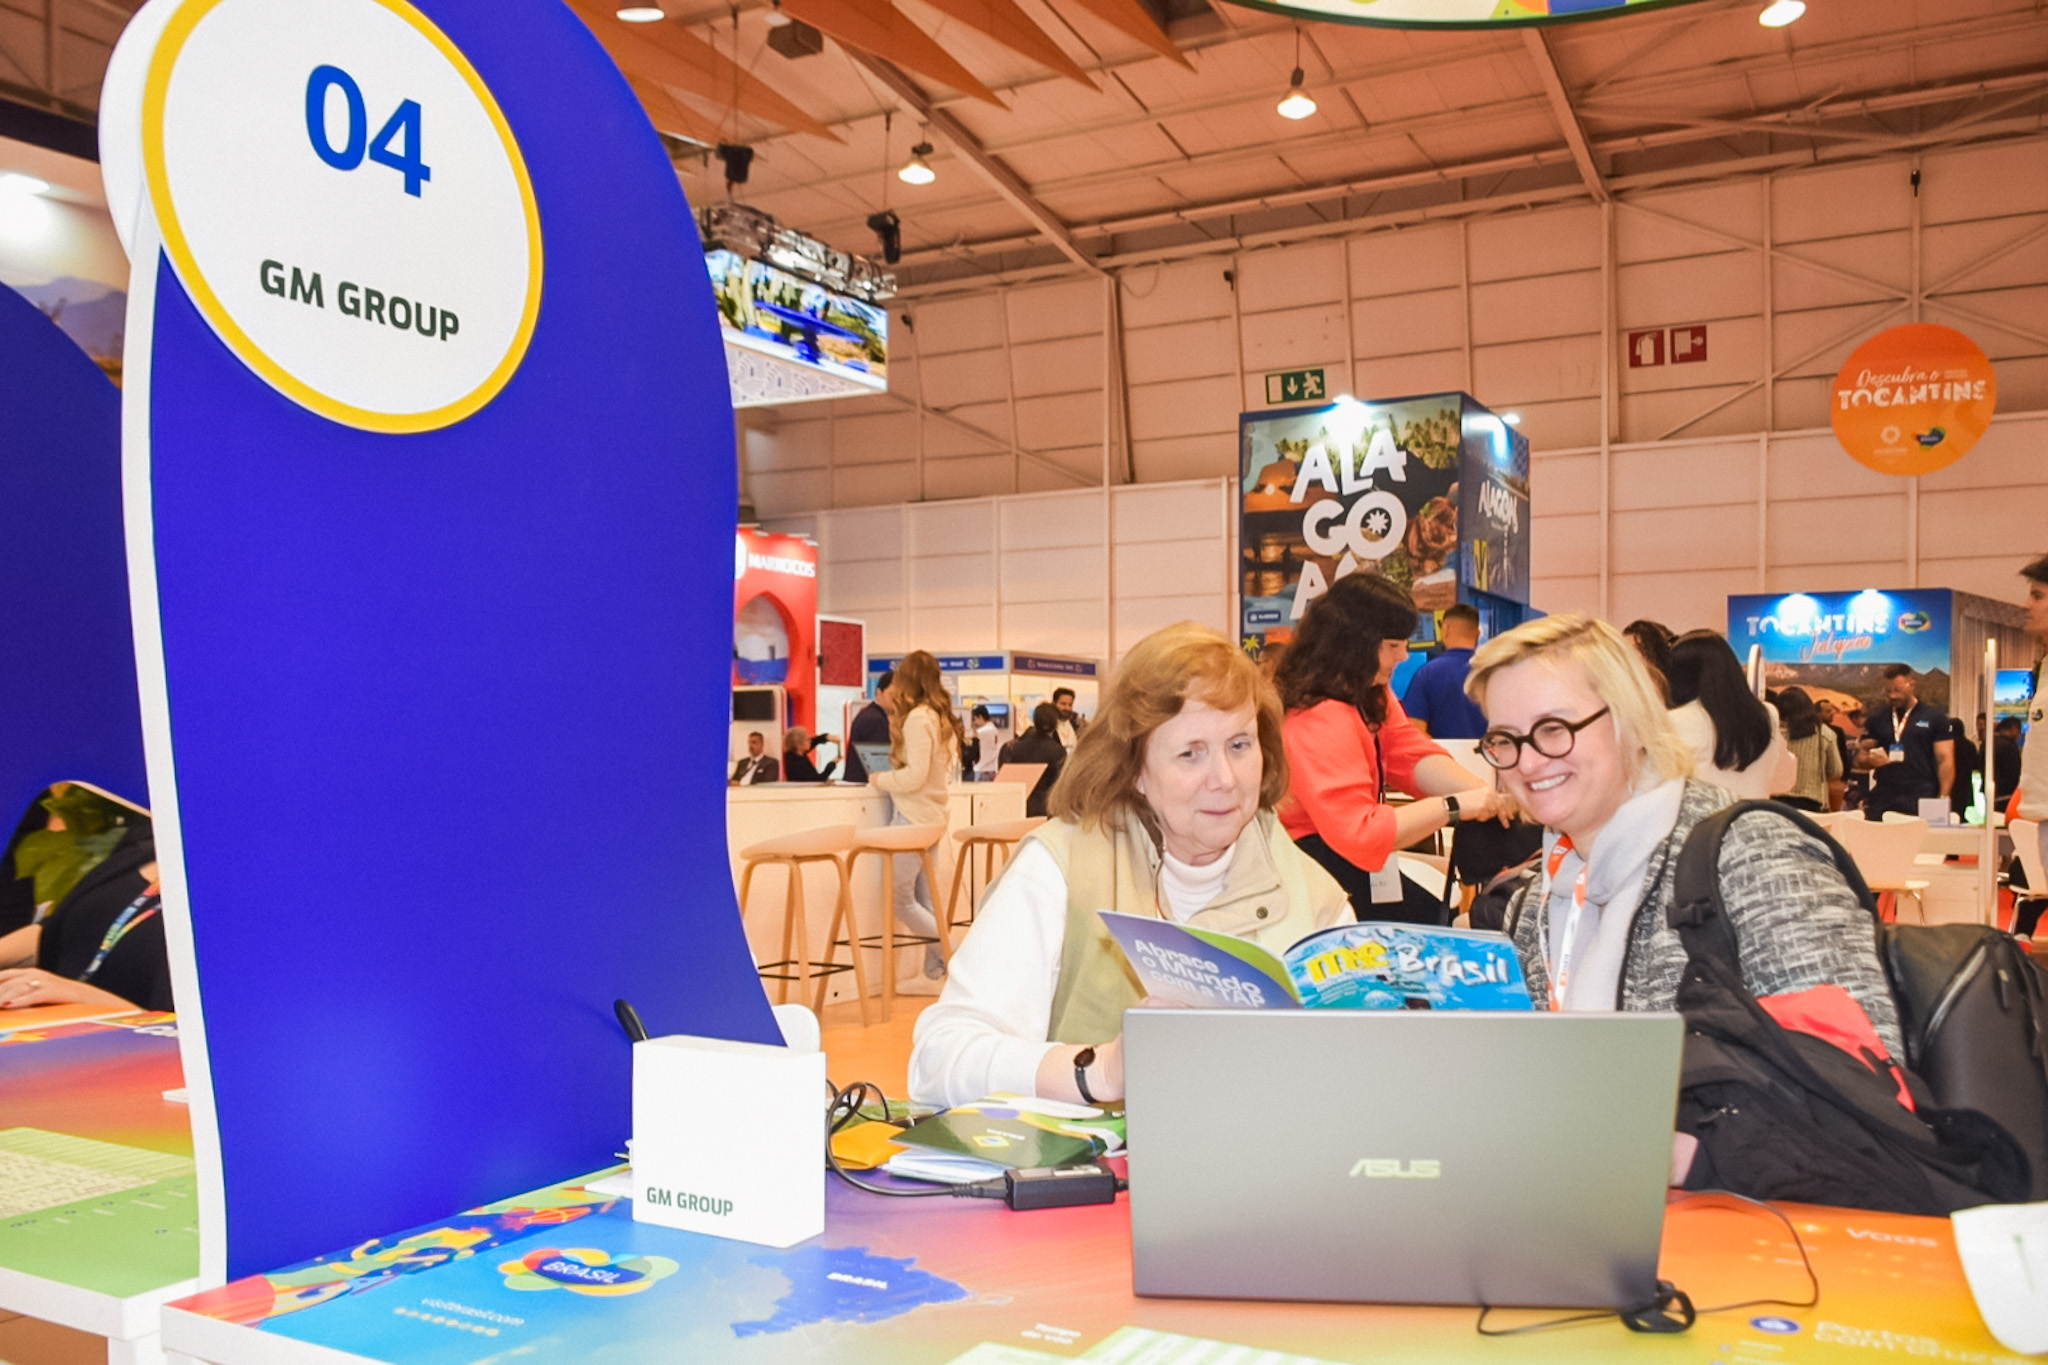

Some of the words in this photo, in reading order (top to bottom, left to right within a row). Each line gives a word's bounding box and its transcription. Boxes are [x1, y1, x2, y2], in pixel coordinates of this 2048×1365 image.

[305, 64, 431, 198] 04
[260, 259, 325, 308] GM
[337, 281, 460, 342] GROUP
[1856, 364, 1928, 387] Descubra
[1837, 379, 1986, 411] TOCANTINS
[1290, 428, 1407, 503] ALA
[1302, 490, 1407, 560] GO
[1746, 613, 1889, 636] TOCANTINS
[1134, 939, 1219, 974] Abrace
[1397, 943, 1510, 987] Brasil
[1142, 956, 1157, 968] o
[1159, 957, 1262, 996] Mundo
[1150, 970, 1197, 992] com
[1215, 985, 1266, 1007] TAP
[1349, 1159, 1441, 1178] ASUS
[647, 1186, 672, 1207] GM
[677, 1192, 734, 1217] GROUP
[1845, 1227, 1939, 1248] Voos
[542, 1260, 621, 1284] BRASIL
